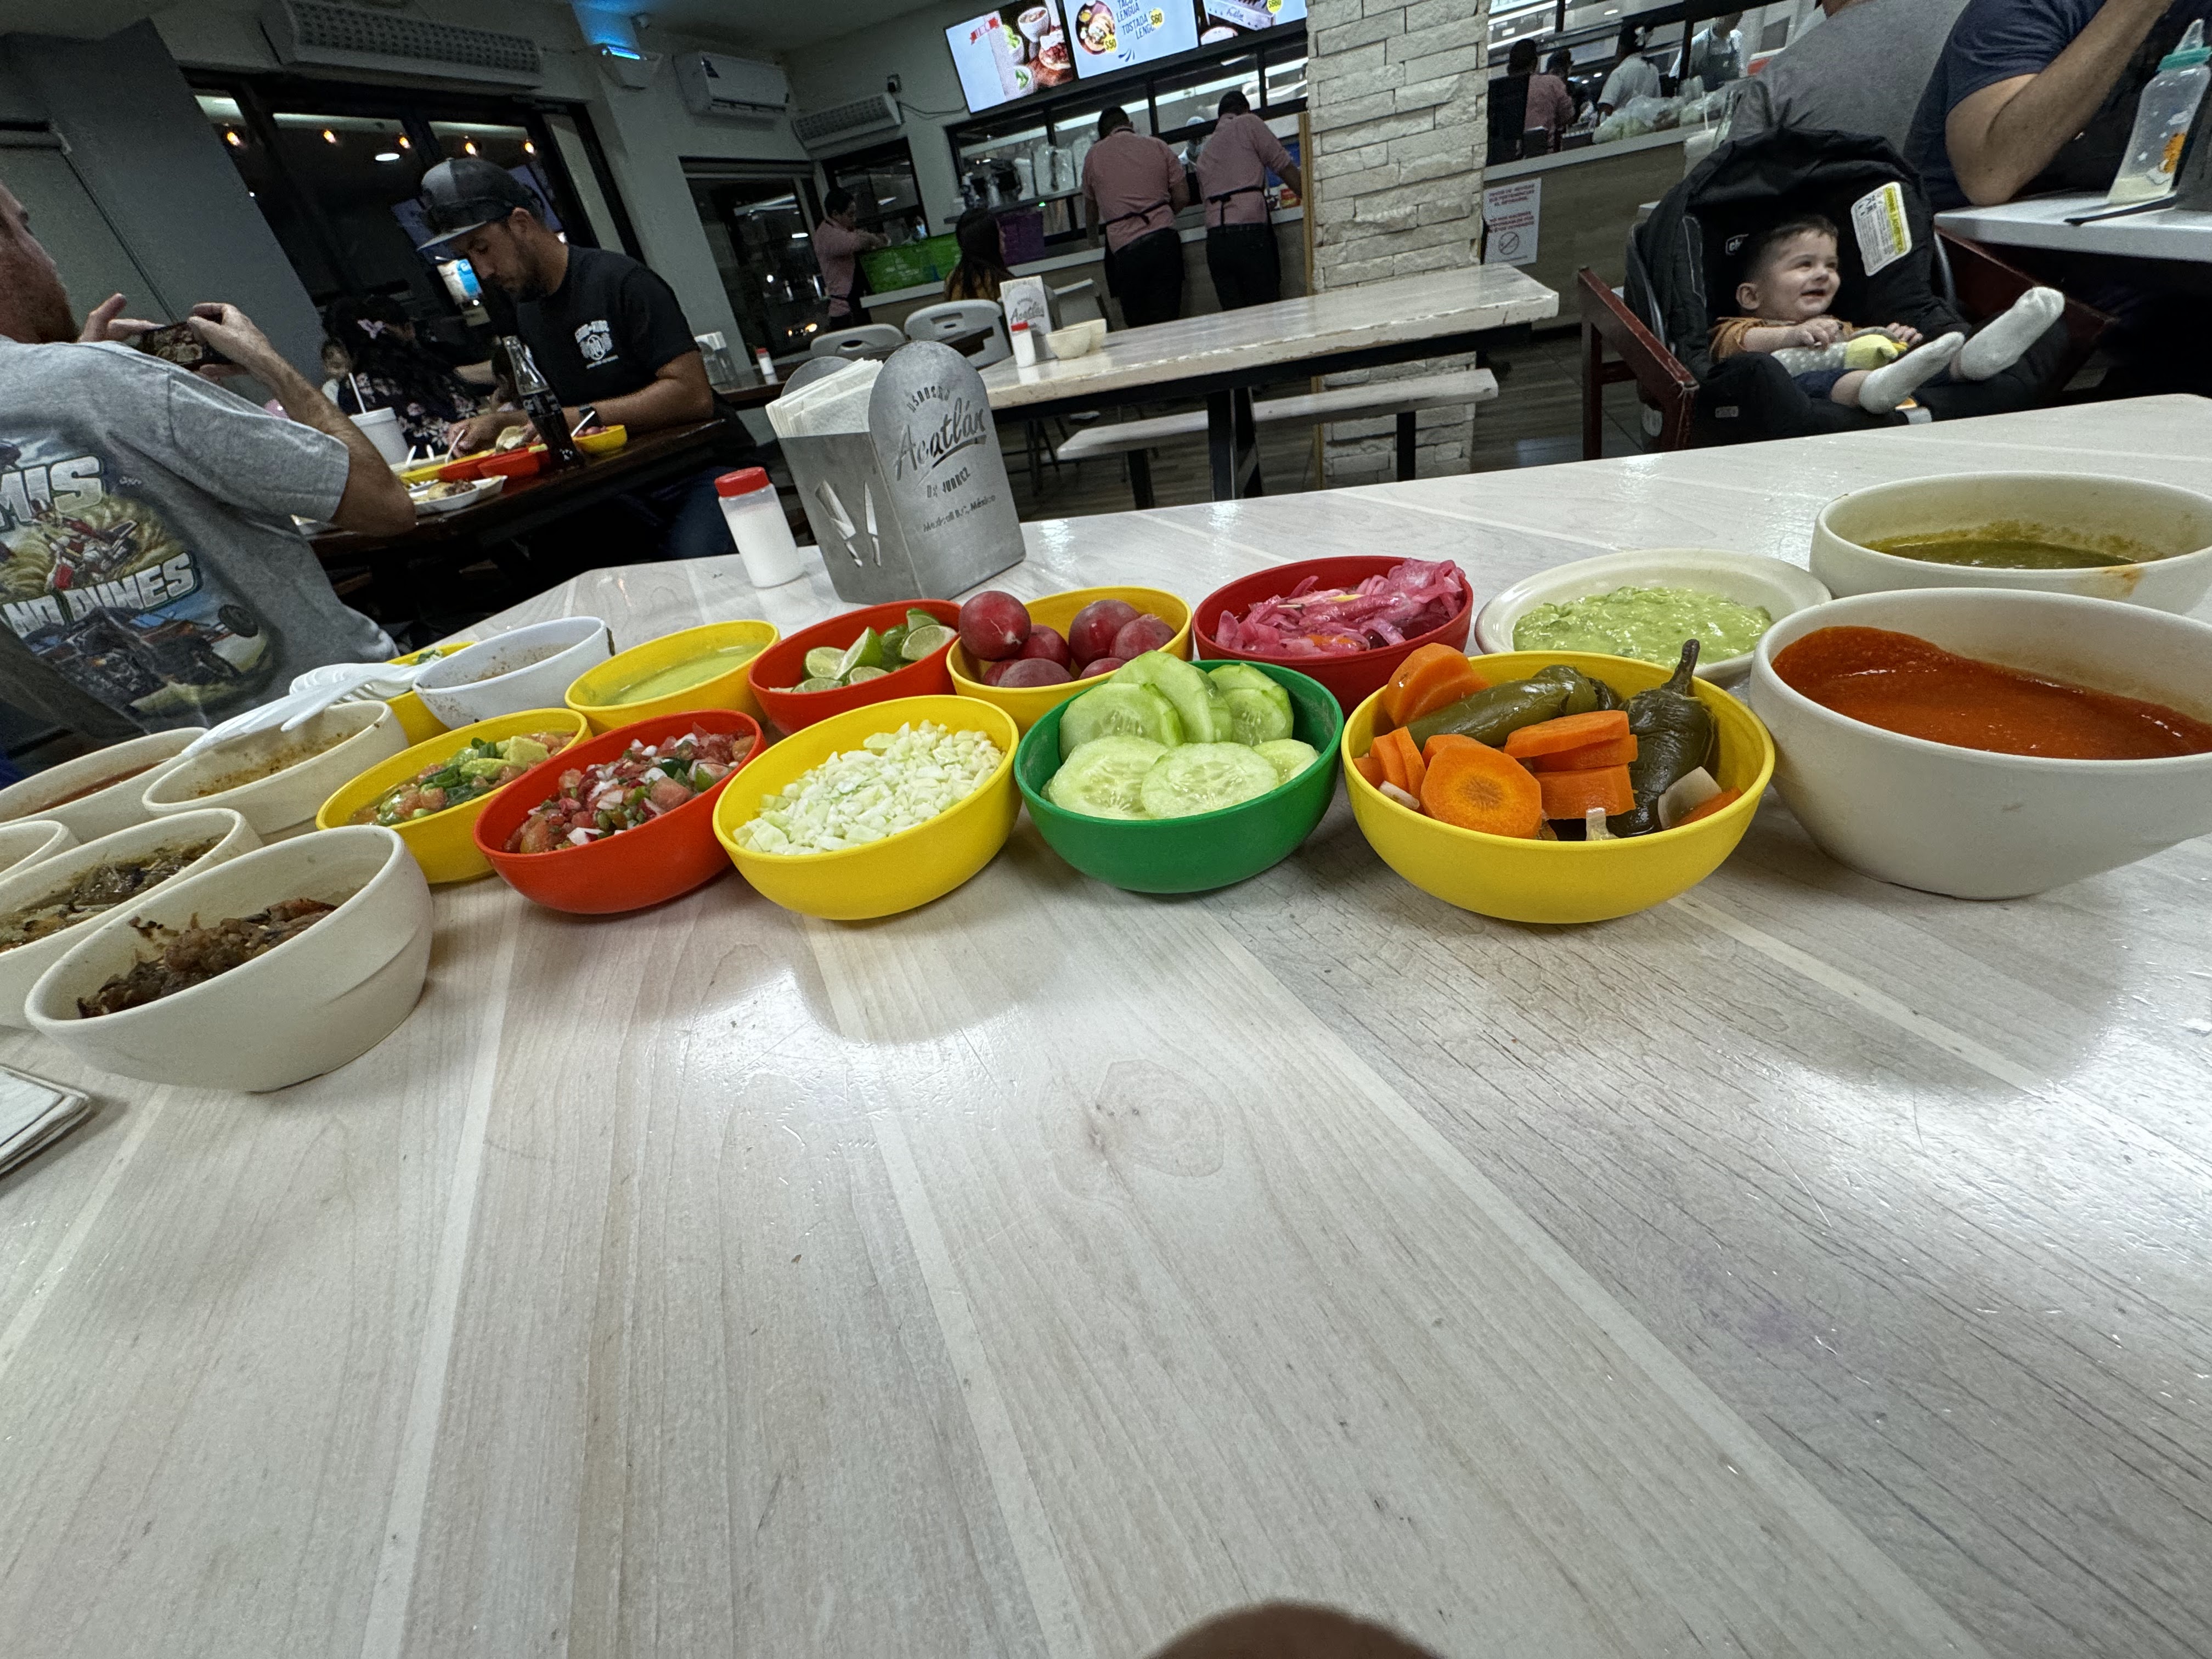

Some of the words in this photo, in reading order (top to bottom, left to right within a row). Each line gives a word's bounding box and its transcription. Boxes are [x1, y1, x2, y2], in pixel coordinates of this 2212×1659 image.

[1116, 2, 1139, 22] LENGUA
[1122, 14, 1148, 35] TOSTADA
[1135, 24, 1155, 40] LENGU
[893, 398, 986, 481] Acatlán
[0, 594, 65, 639] ND
[62, 552, 195, 622] DUNES
